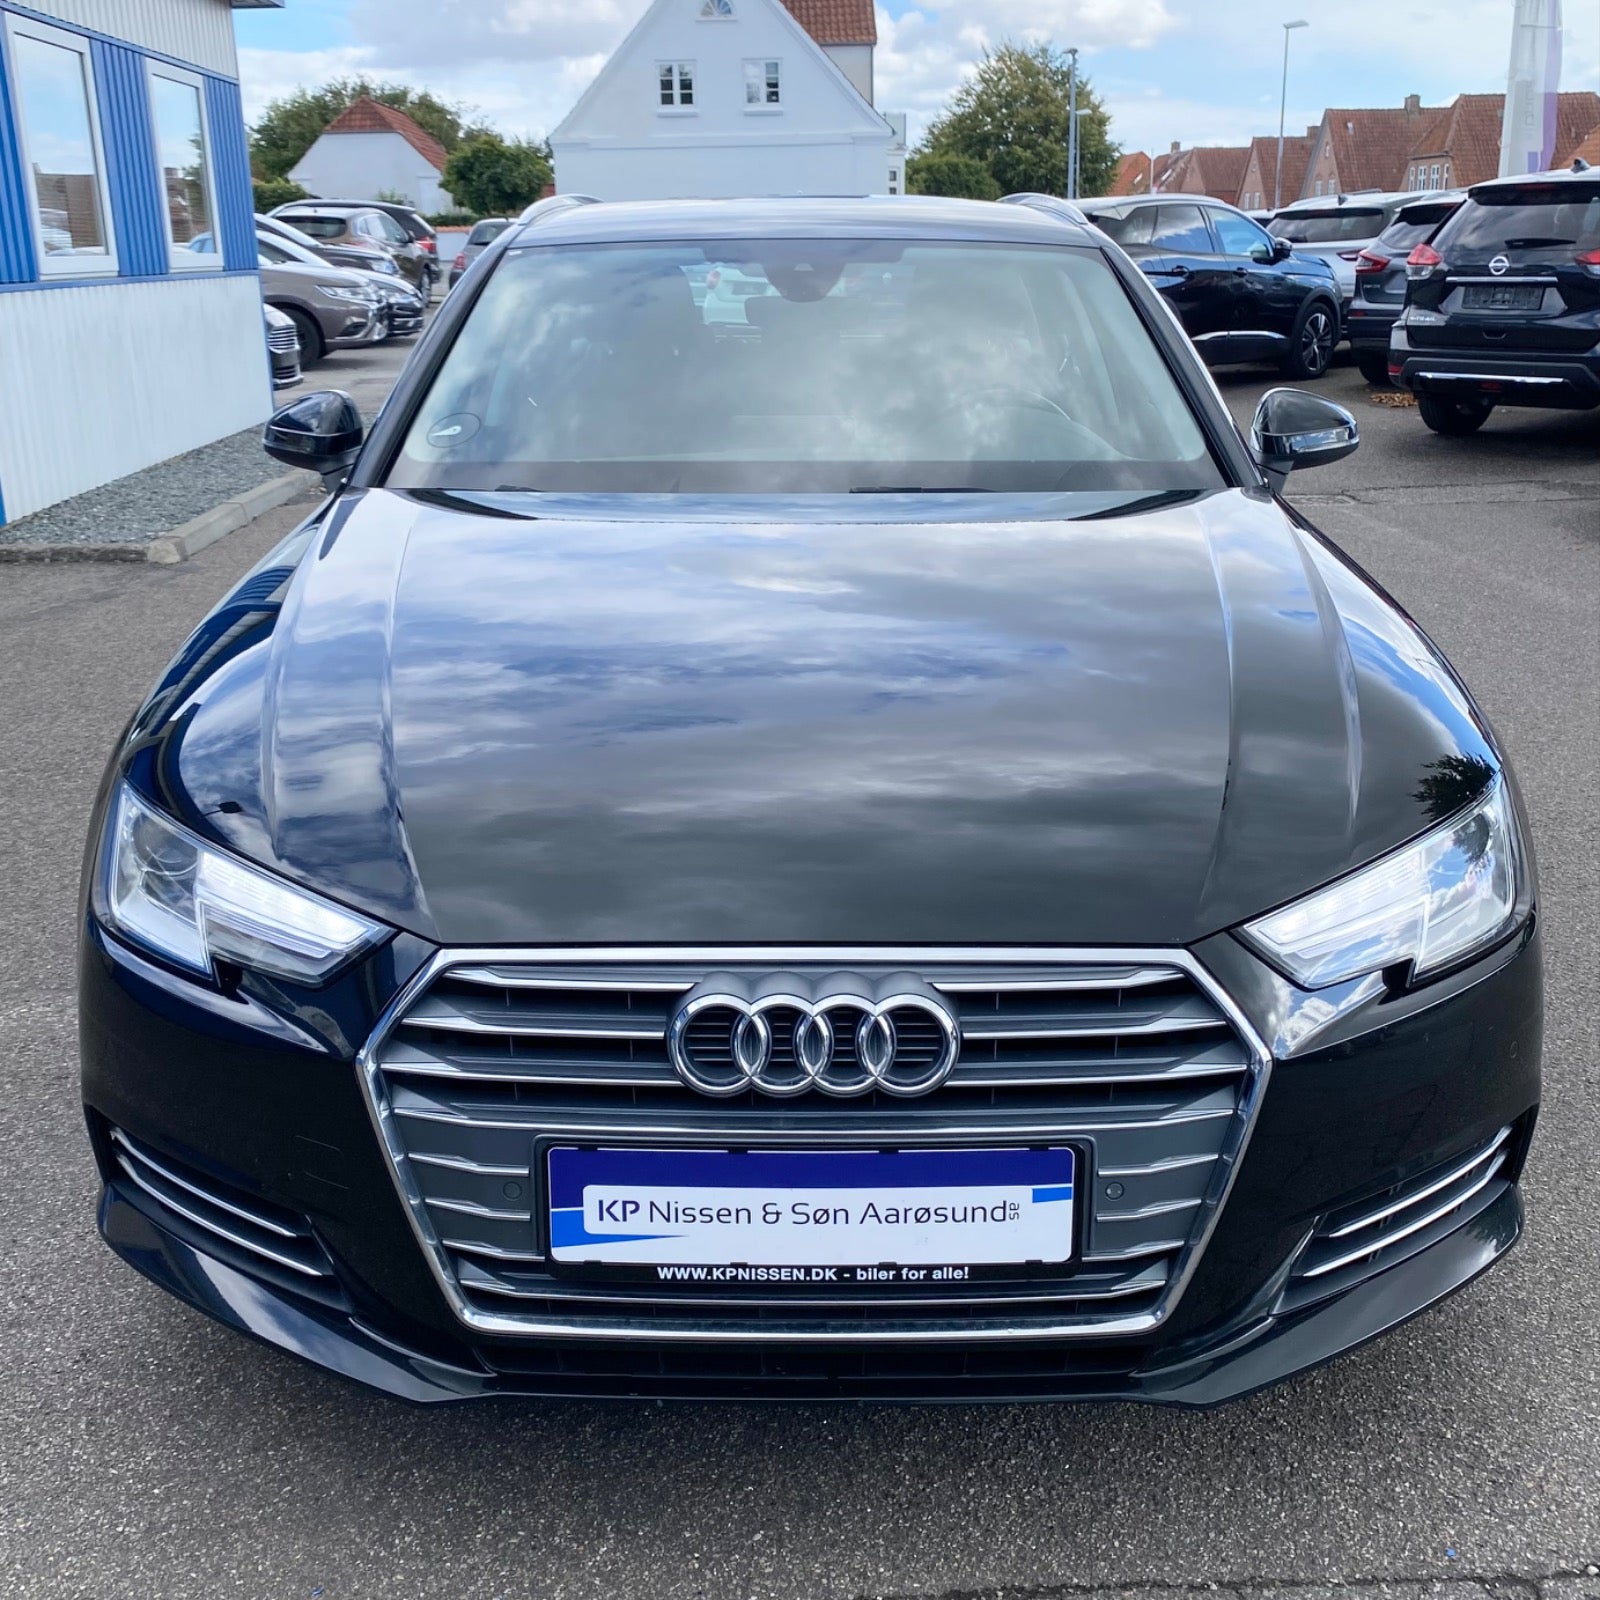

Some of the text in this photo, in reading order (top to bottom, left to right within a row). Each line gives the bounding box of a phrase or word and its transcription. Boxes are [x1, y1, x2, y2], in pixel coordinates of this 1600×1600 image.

[598, 1199, 1007, 1225] KP Nissen & Søn Aarøsund
[656, 1266, 838, 1281] WWW.KPNISSEN.DK
[855, 1267, 897, 1281] biler
[900, 1266, 927, 1280] for
[931, 1266, 970, 1280] alle!
